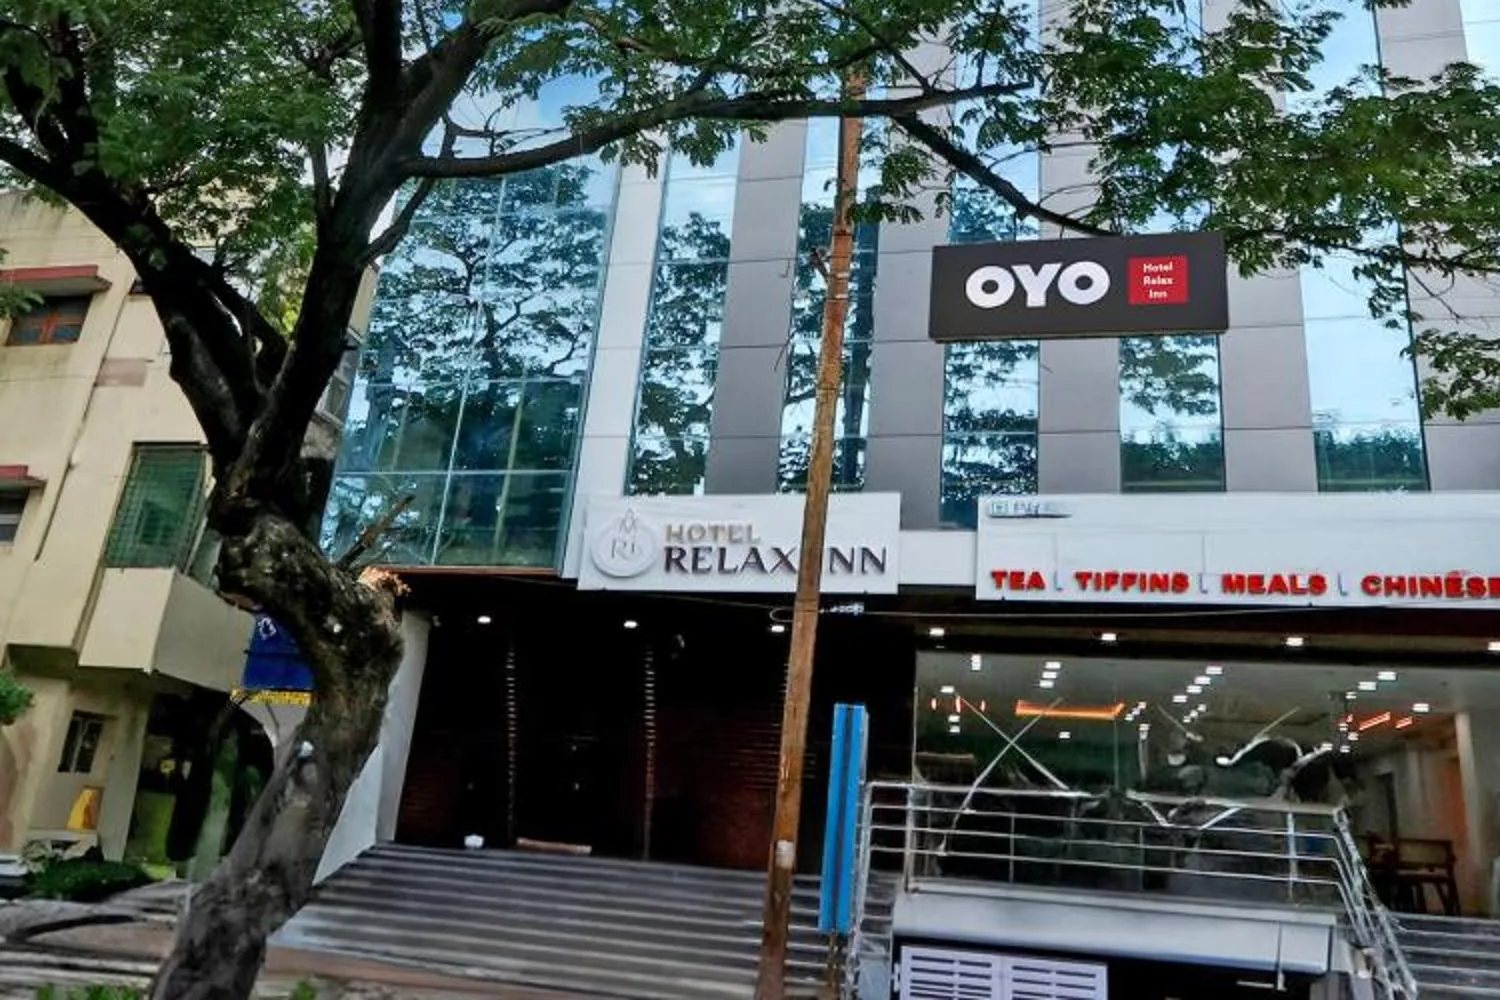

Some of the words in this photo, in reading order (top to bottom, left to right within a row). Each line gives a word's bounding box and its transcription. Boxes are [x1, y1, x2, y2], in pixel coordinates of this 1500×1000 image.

[1143, 261, 1173, 273] Hotel
[965, 261, 1110, 308] OYO
[1149, 289, 1168, 299] Inn
[665, 523, 761, 545] HOTEL
[664, 546, 799, 575] RELAX
[829, 547, 888, 574] NN
[991, 570, 1046, 591] TEA
[1075, 571, 1190, 594] TIFFINS
[1222, 573, 1328, 596] MEALS
